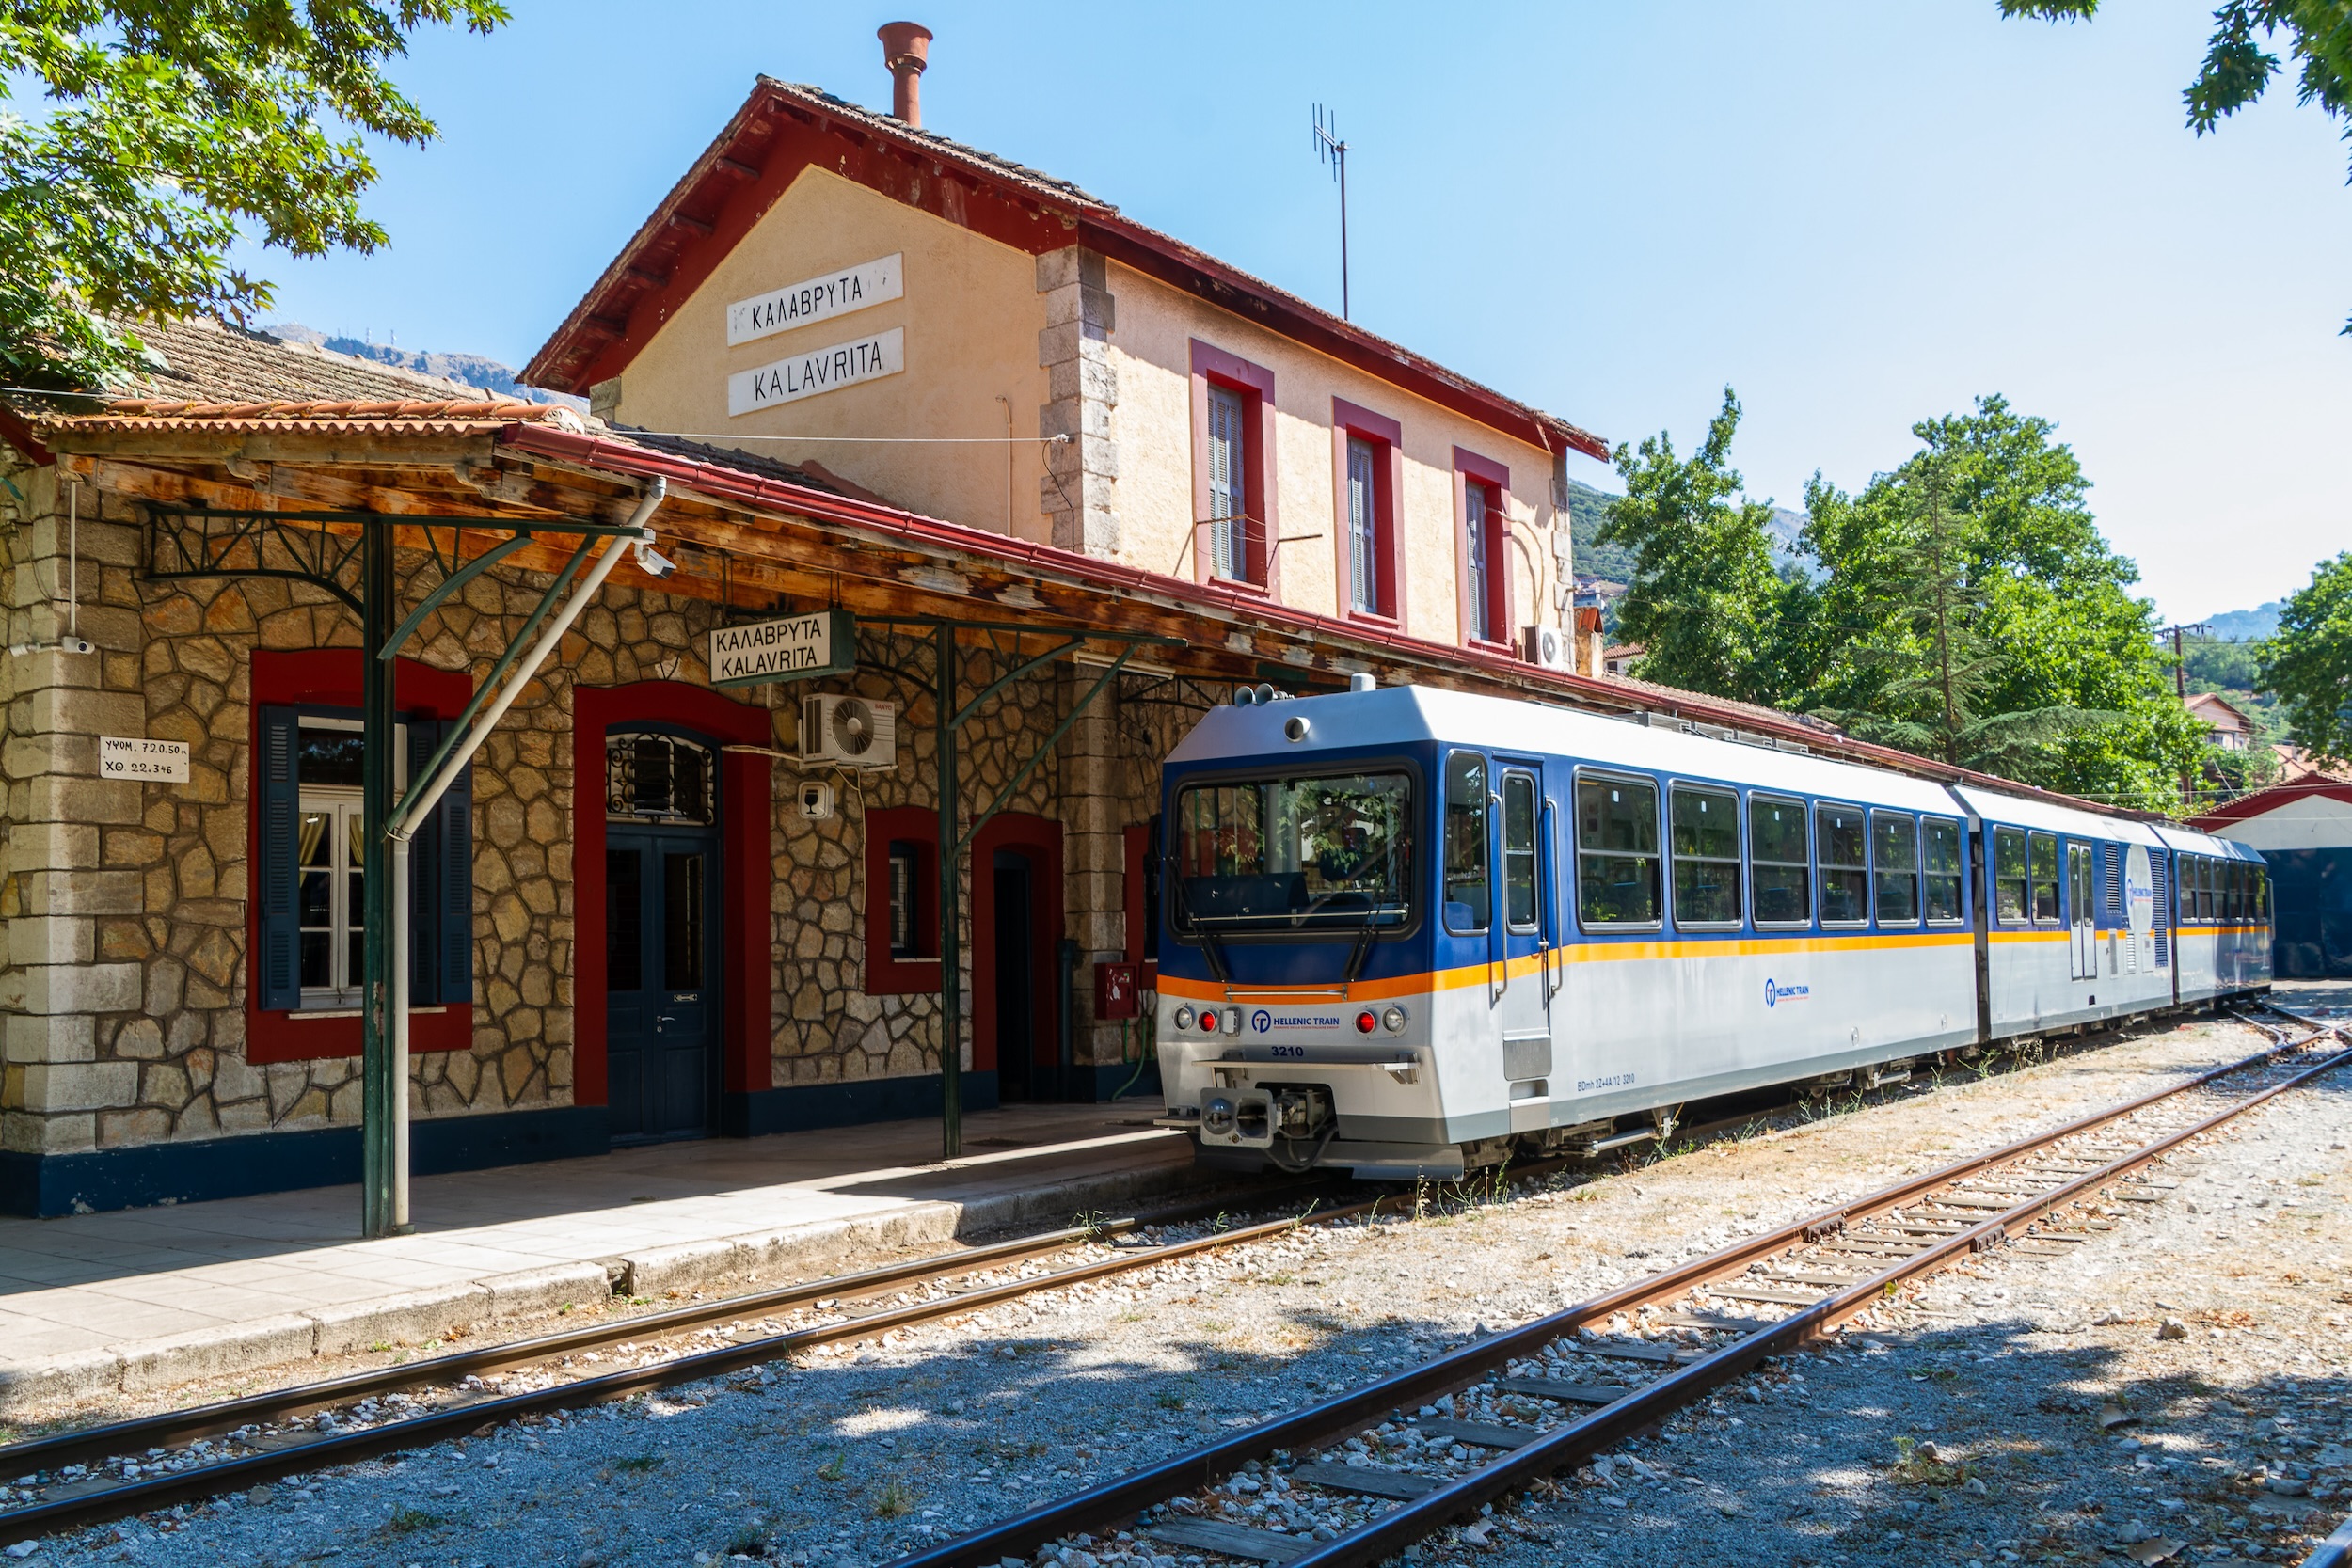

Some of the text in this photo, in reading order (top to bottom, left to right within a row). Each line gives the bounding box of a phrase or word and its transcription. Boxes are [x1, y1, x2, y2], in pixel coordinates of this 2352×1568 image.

[752, 274, 863, 331] ΚΑΛΑΒΡΥΤΑ
[754, 341, 882, 401] KALAVRITA
[717, 619, 821, 652] ΚΑΛΑΒΡΥΤΑ
[722, 646, 817, 677] KALAVRITA
[131, 762, 173, 774] 22.346
[1271, 1046, 1303, 1056] 3210
[1623, 1073, 1634, 1084] 3210
